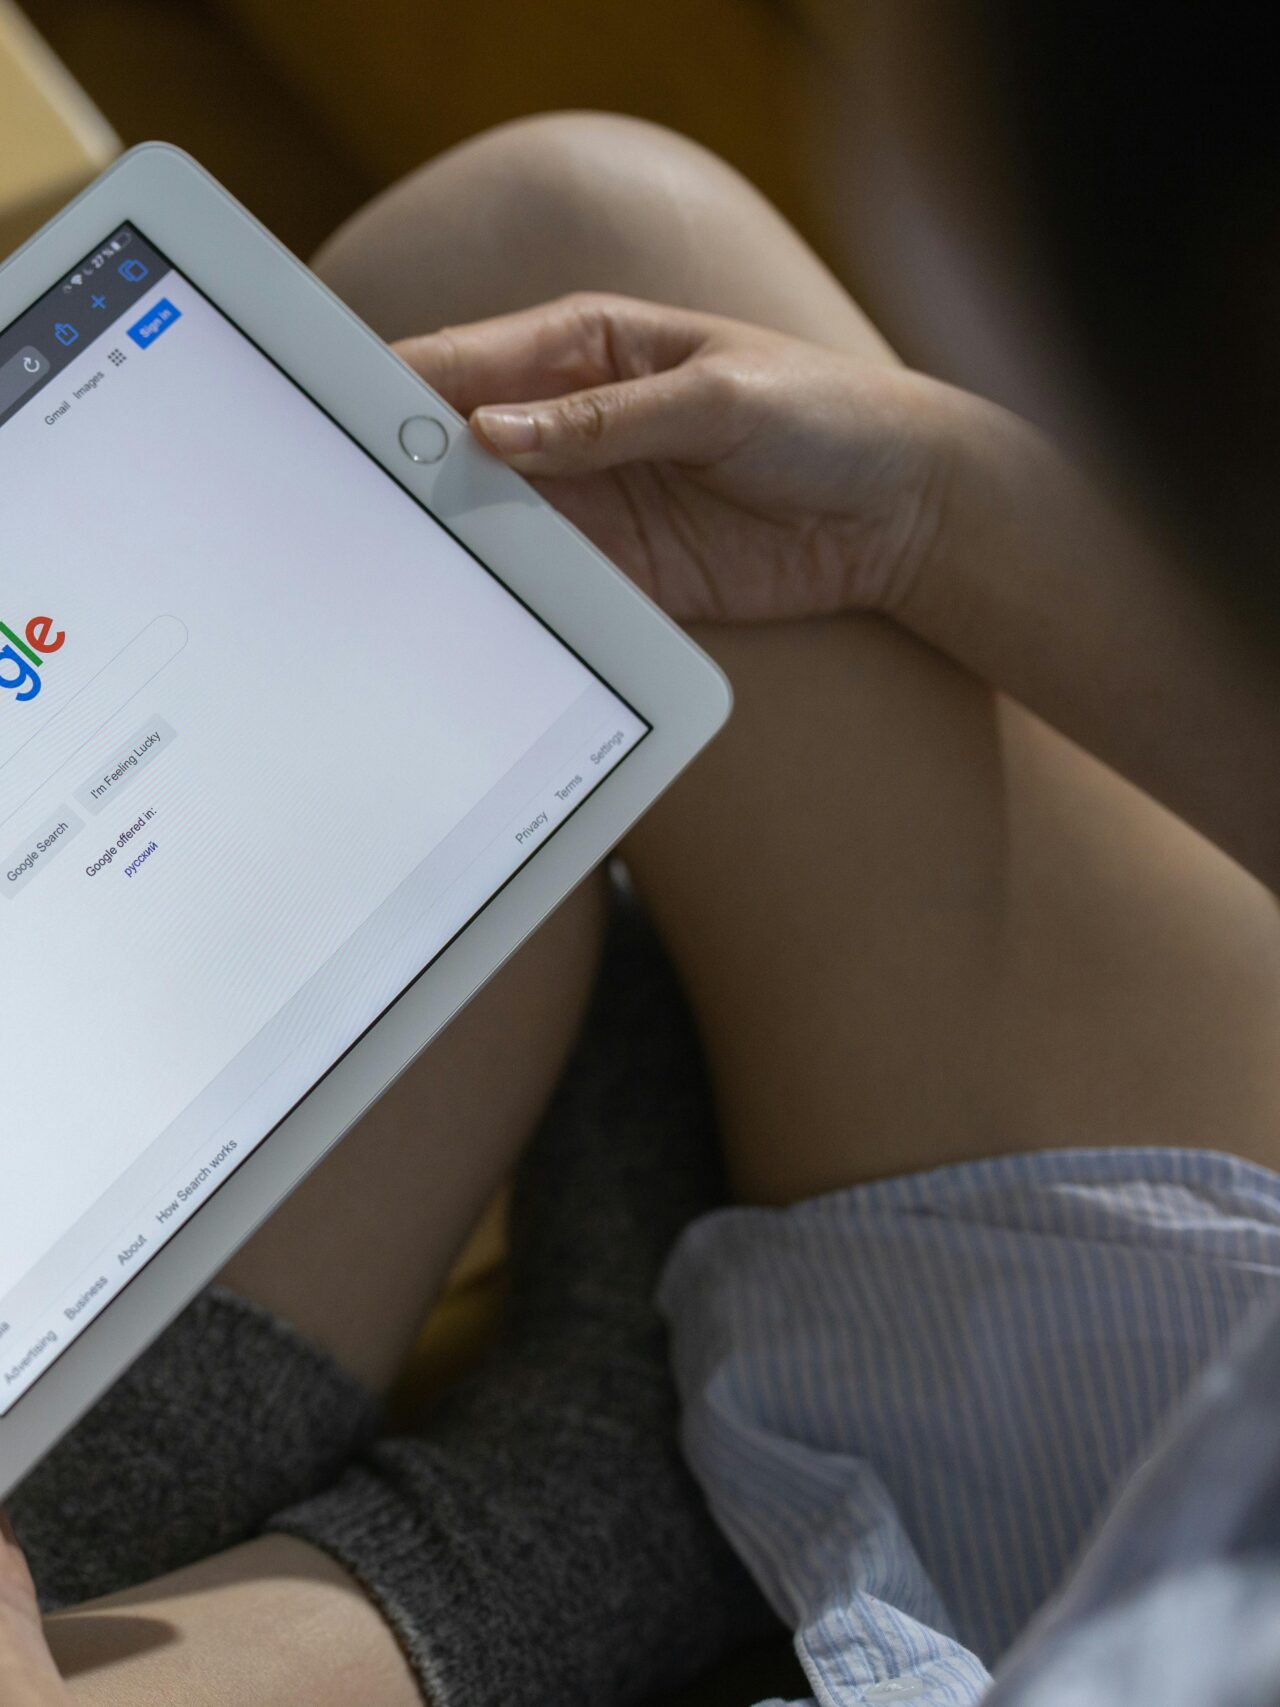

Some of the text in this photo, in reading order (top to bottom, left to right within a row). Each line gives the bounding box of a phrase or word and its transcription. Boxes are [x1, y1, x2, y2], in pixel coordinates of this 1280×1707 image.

[139, 309, 172, 339] Sign in
[44, 371, 104, 426] Gmail Images
[90, 731, 162, 800] I'm Feeling Lucky
[515, 730, 624, 844] Privacy Terms Settings
[6, 821, 69, 883] Google Search
[86, 806, 157, 878] Google offered in:
[124, 841, 158, 878] русский
[3, 1138, 238, 1384] Advertising Business About How Search works
